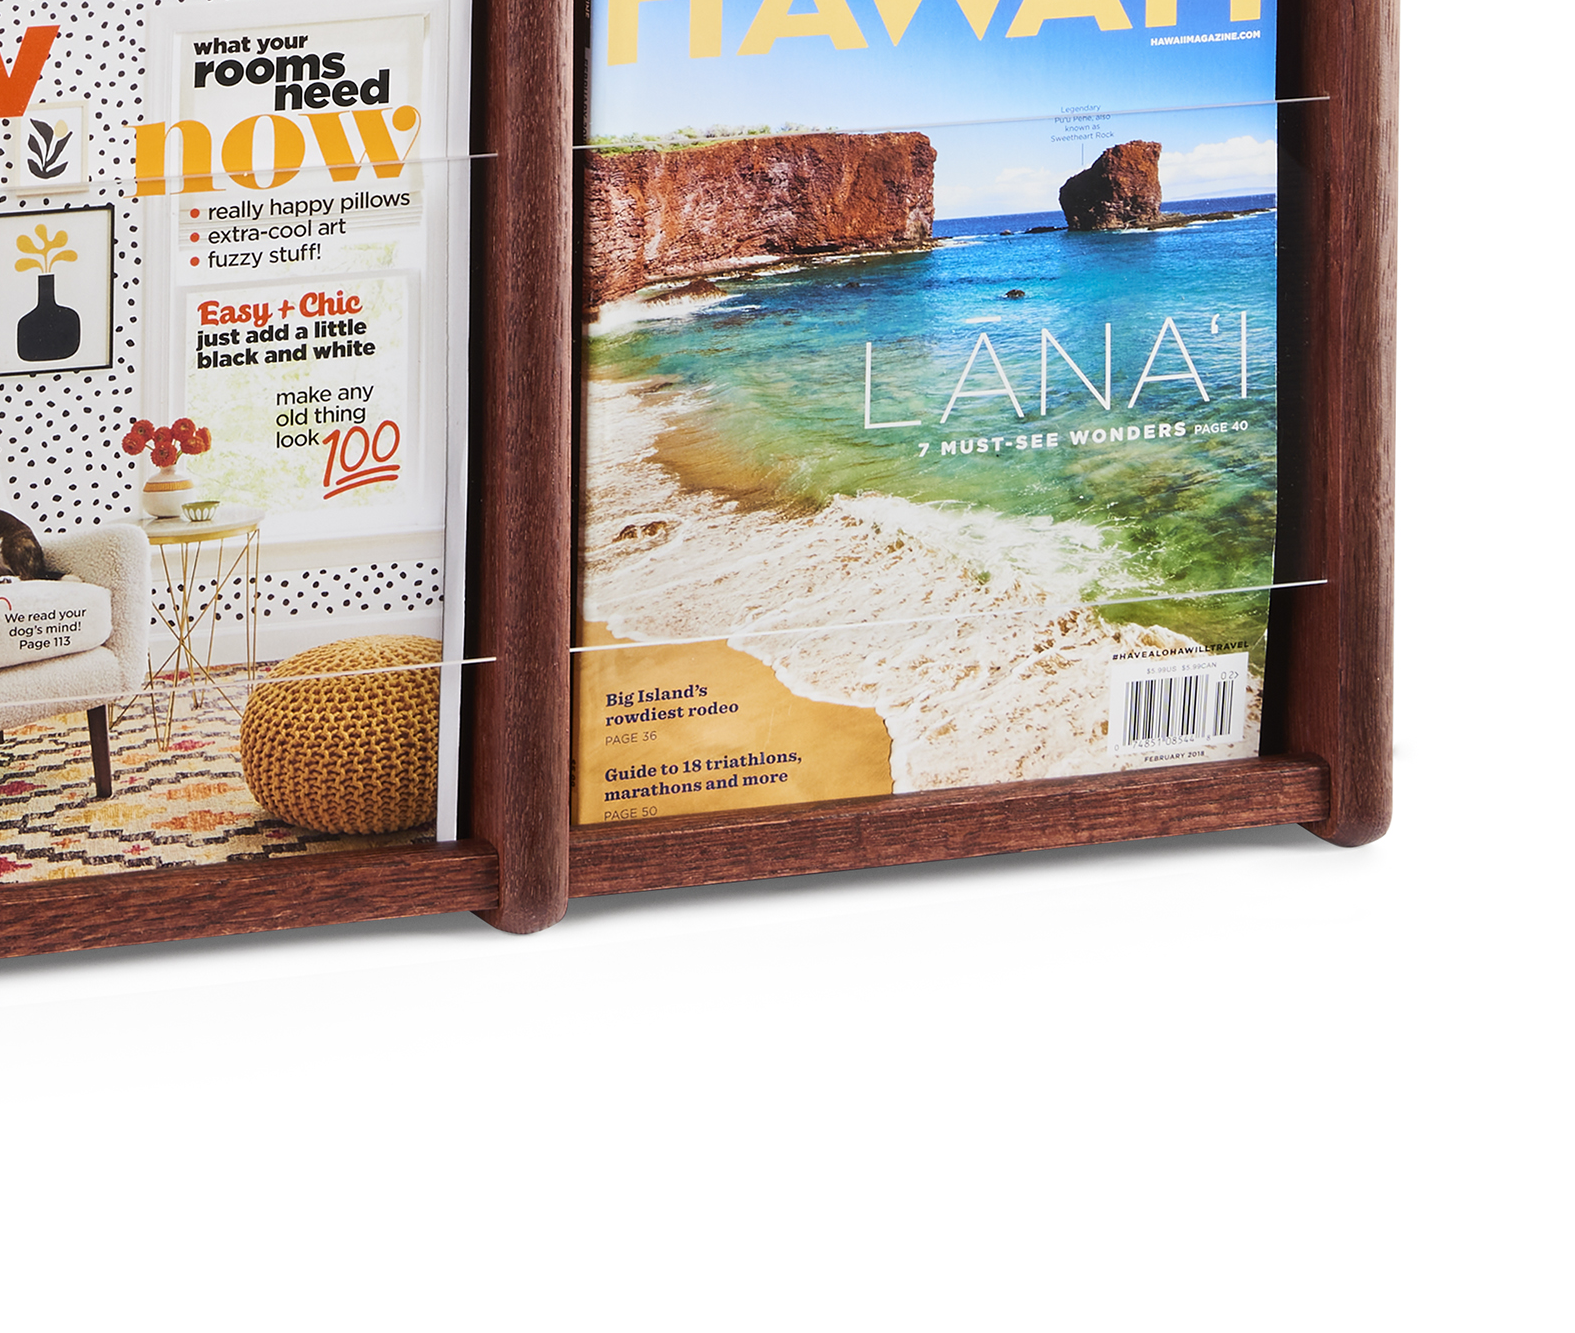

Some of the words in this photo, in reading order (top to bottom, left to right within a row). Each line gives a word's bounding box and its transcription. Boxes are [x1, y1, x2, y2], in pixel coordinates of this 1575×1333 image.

[194, 37, 250, 56] what
[256, 33, 308, 54] your
[1150, 30, 1261, 47] HAWAIIMAGAZINE.COM
[194, 47, 345, 89] rooms
[273, 70, 390, 111] need
[123, 107, 423, 199] now
[208, 200, 263, 222] really
[270, 197, 334, 219] happy
[341, 192, 410, 213] pillows
[197, 300, 272, 328] Easy
[278, 300, 295, 319] +
[299, 290, 363, 318] Chic
[918, 443, 929, 457] 7
[941, 436, 1059, 456] MUST-SEE
[1069, 422, 1186, 446] WONDERS
[1194, 422, 1229, 434] PAGE
[1231, 420, 1248, 431] 40
[5, 614, 25, 623] We
[28, 610, 55, 621] read
[59, 609, 86, 621] your
[20, 639, 50, 650] Page
[54, 636, 71, 646] 113
[1112, 641, 1249, 660] #HAVEALOHAWILLTRAVEL
[606, 693, 634, 707] Big
[638, 684, 708, 703] Island’s
[1144, 753, 1185, 762] FEBRUARY
